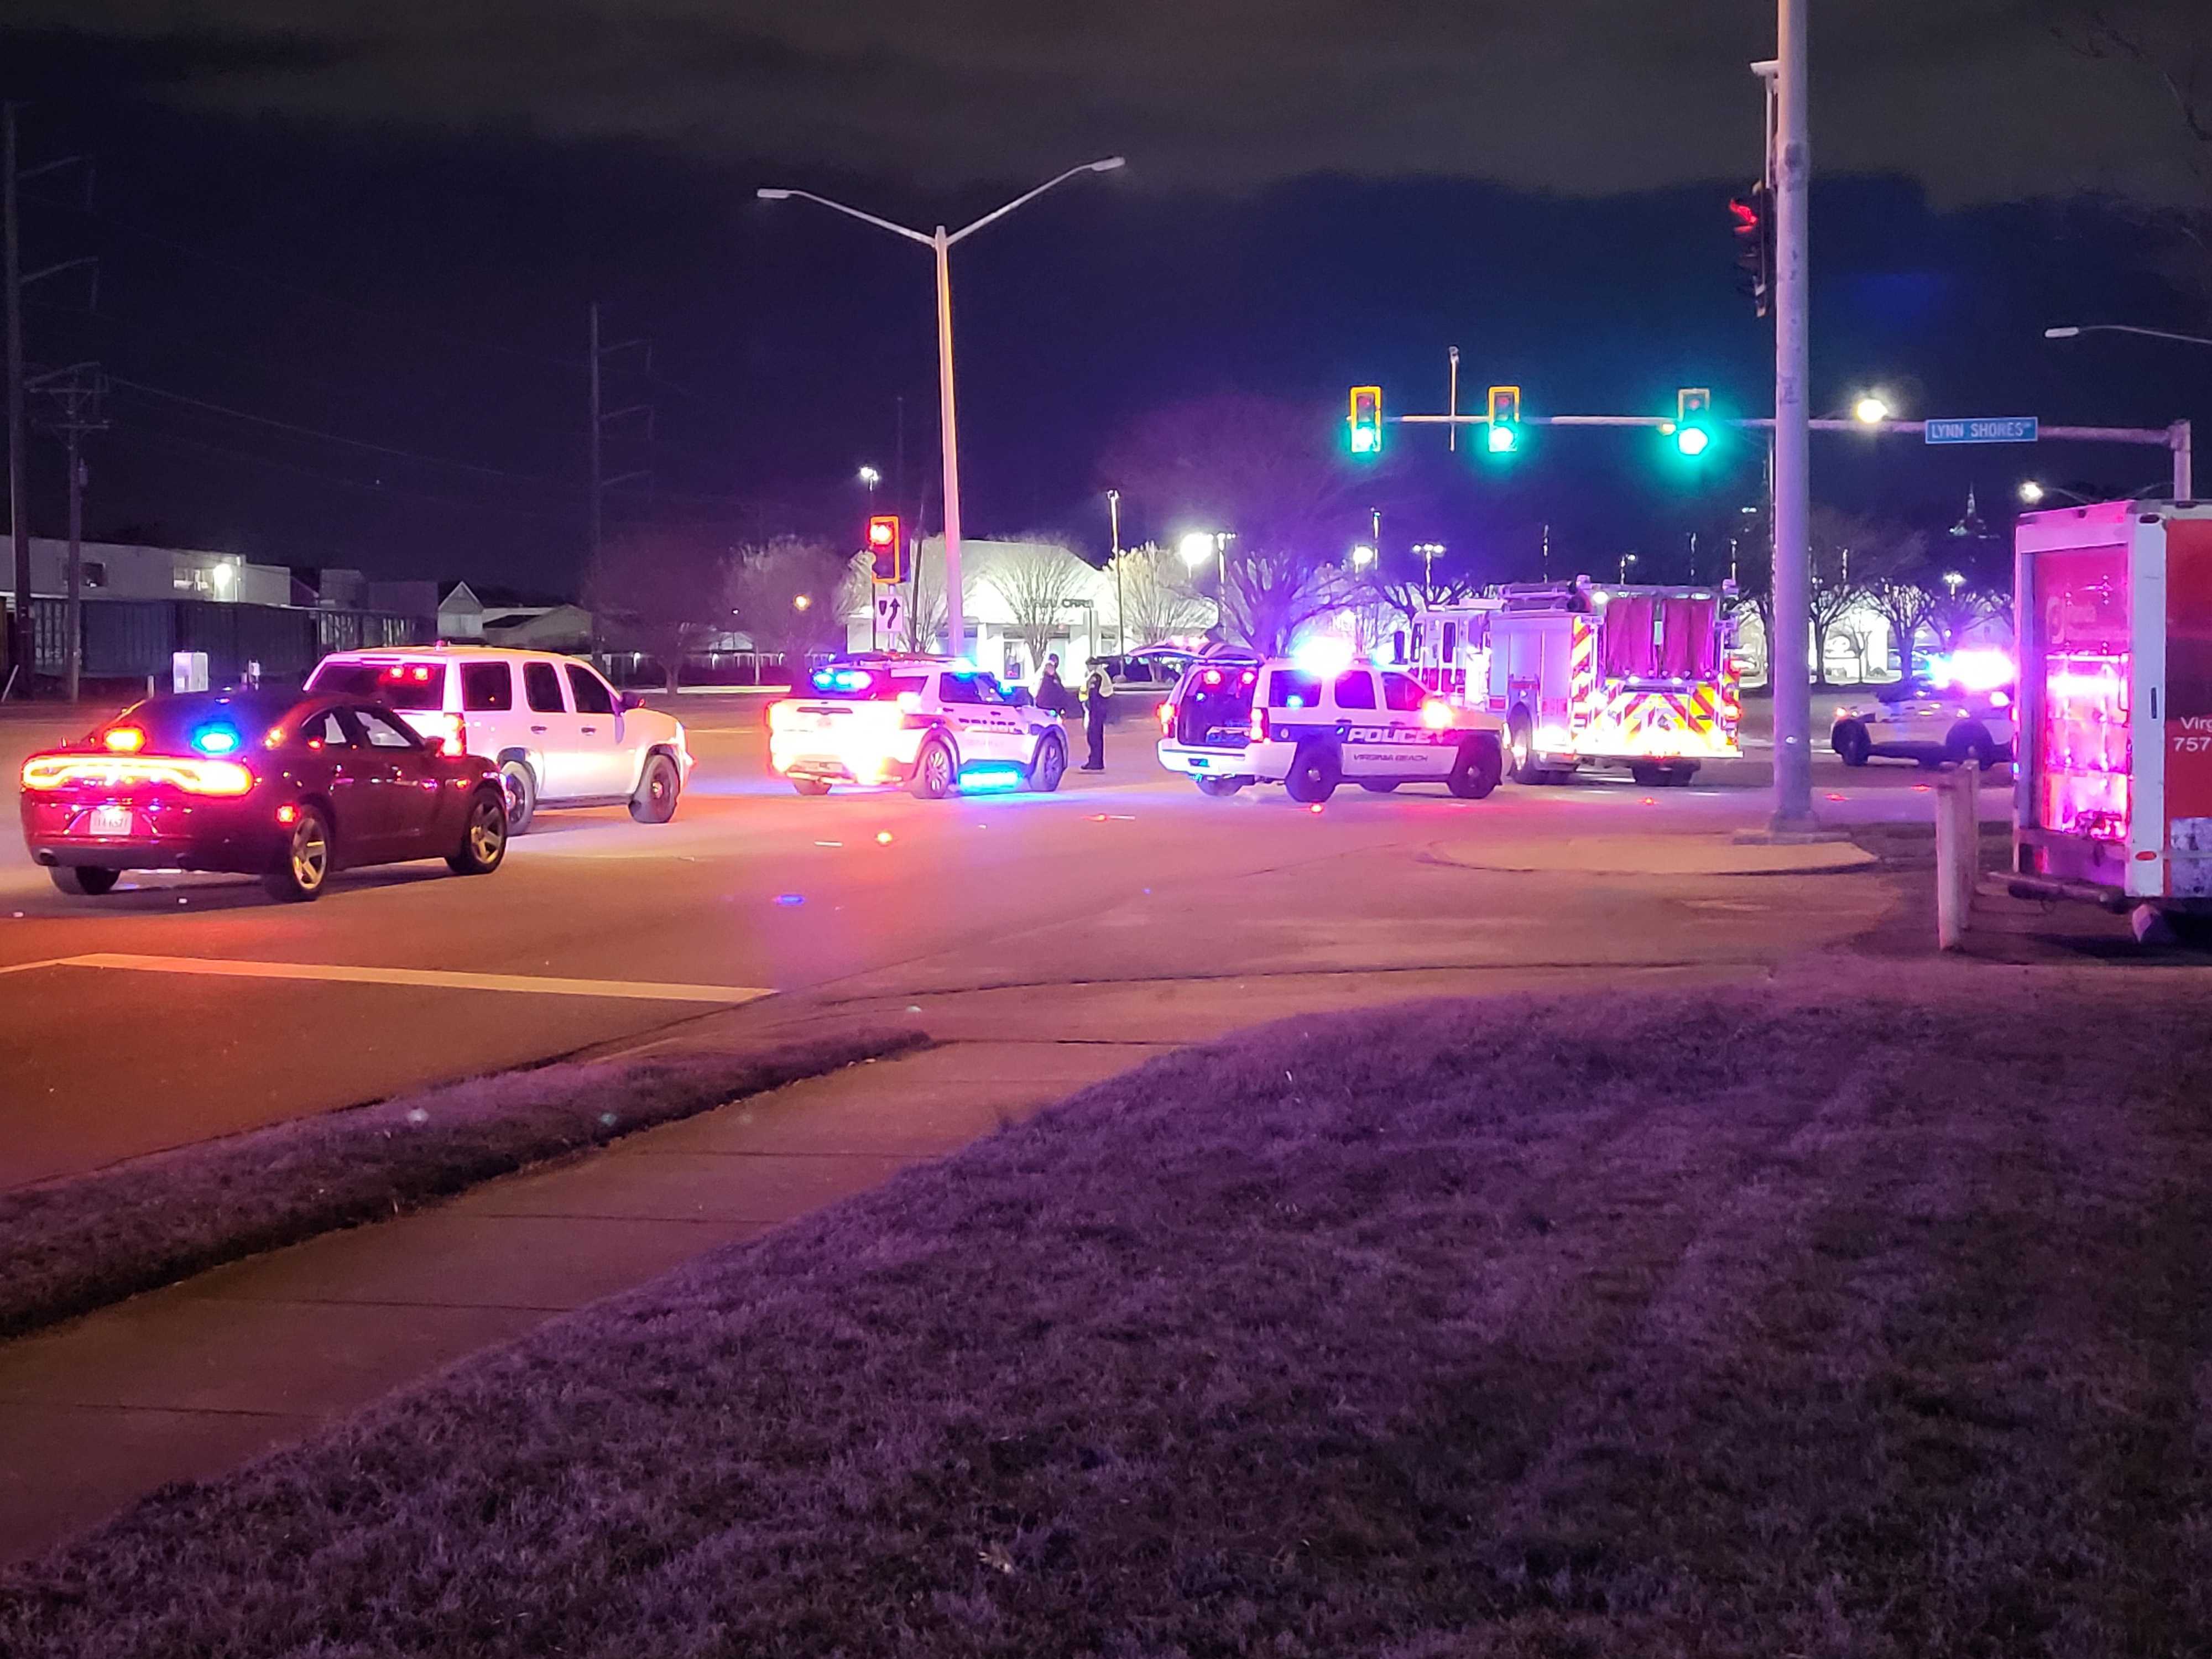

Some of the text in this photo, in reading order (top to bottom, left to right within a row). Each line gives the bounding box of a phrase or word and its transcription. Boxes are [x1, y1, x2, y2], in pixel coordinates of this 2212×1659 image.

[1932, 424, 1963, 439] LYNN
[1970, 422, 2024, 437] SHORES
[1348, 728, 1431, 744] POLICE
[2173, 737, 2211, 752] 757
